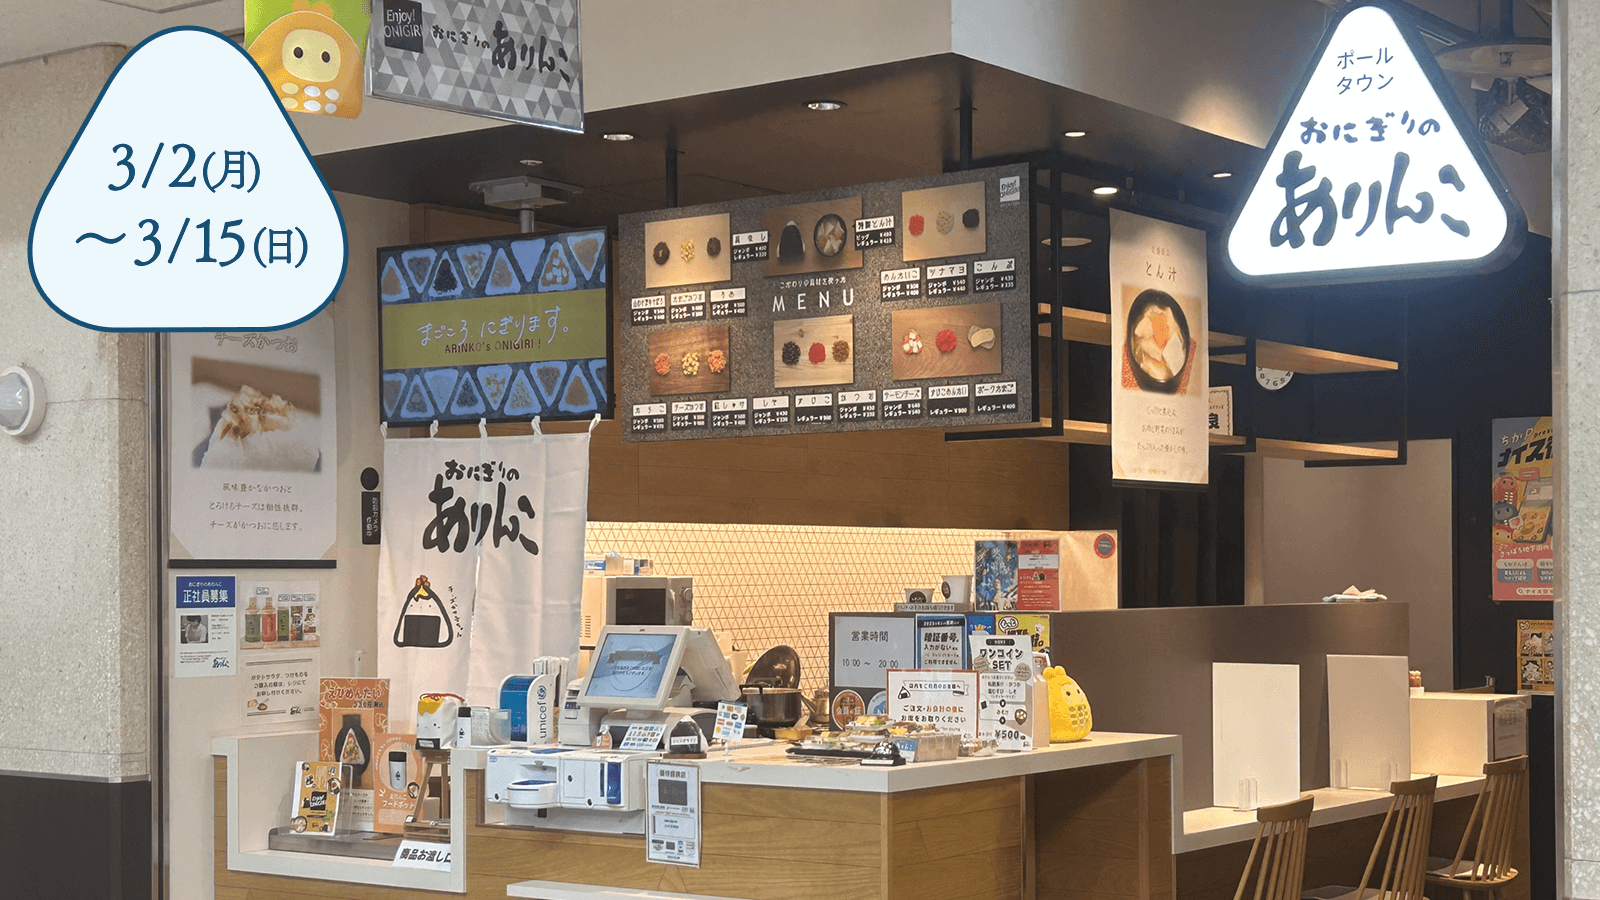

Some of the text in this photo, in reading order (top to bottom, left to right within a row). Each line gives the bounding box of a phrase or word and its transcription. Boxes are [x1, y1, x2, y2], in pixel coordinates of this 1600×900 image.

[387, 9, 416, 22] Enjoy!
[432, 24, 490, 49] おにぎりの
[492, 20, 570, 82] ありんこ
[1337, 47, 1394, 69] ポール
[1337, 74, 1394, 95] タウン
[1300, 110, 1441, 145] おにぎりの
[1270, 150, 1470, 249] ありんこ
[929, 266, 965, 276] ツナマヨ
[1146, 261, 1177, 281] とん汁
[976, 277, 994, 285] ジャンボ
[976, 283, 999, 291] レギュラー
[928, 287, 951, 295] レギュラー
[772, 288, 853, 312] MENU
[480, 306, 569, 345] にぎります。
[215, 332, 298, 353] チーズかつお
[445, 341, 491, 353] ARINKO's
[495, 339, 534, 350] ONIGIRI
[884, 390, 920, 400] サーモンチーズ
[445, 459, 519, 482] おにぎりの
[223, 483, 292, 493] 風味豊かなかつおと
[209, 502, 303, 512] とろけるチーズは相性抜群。
[423, 473, 539, 555] ありんこ
[210, 520, 303, 531] チーズがかつおに恋します。
[183, 590, 228, 603] 正社員募集
[851, 630, 889, 642] 営業時間
[980, 648, 1024, 660] ワンコイン
[842, 658, 861, 667] 10:00
[878, 659, 899, 668] 20:00
[992, 660, 1012, 671] SET
[329, 687, 381, 699] えびめんたい
[537, 701, 547, 739] unicef
[995, 730, 1019, 739] ¥500
[400, 848, 451, 864] 商品お渡し口
